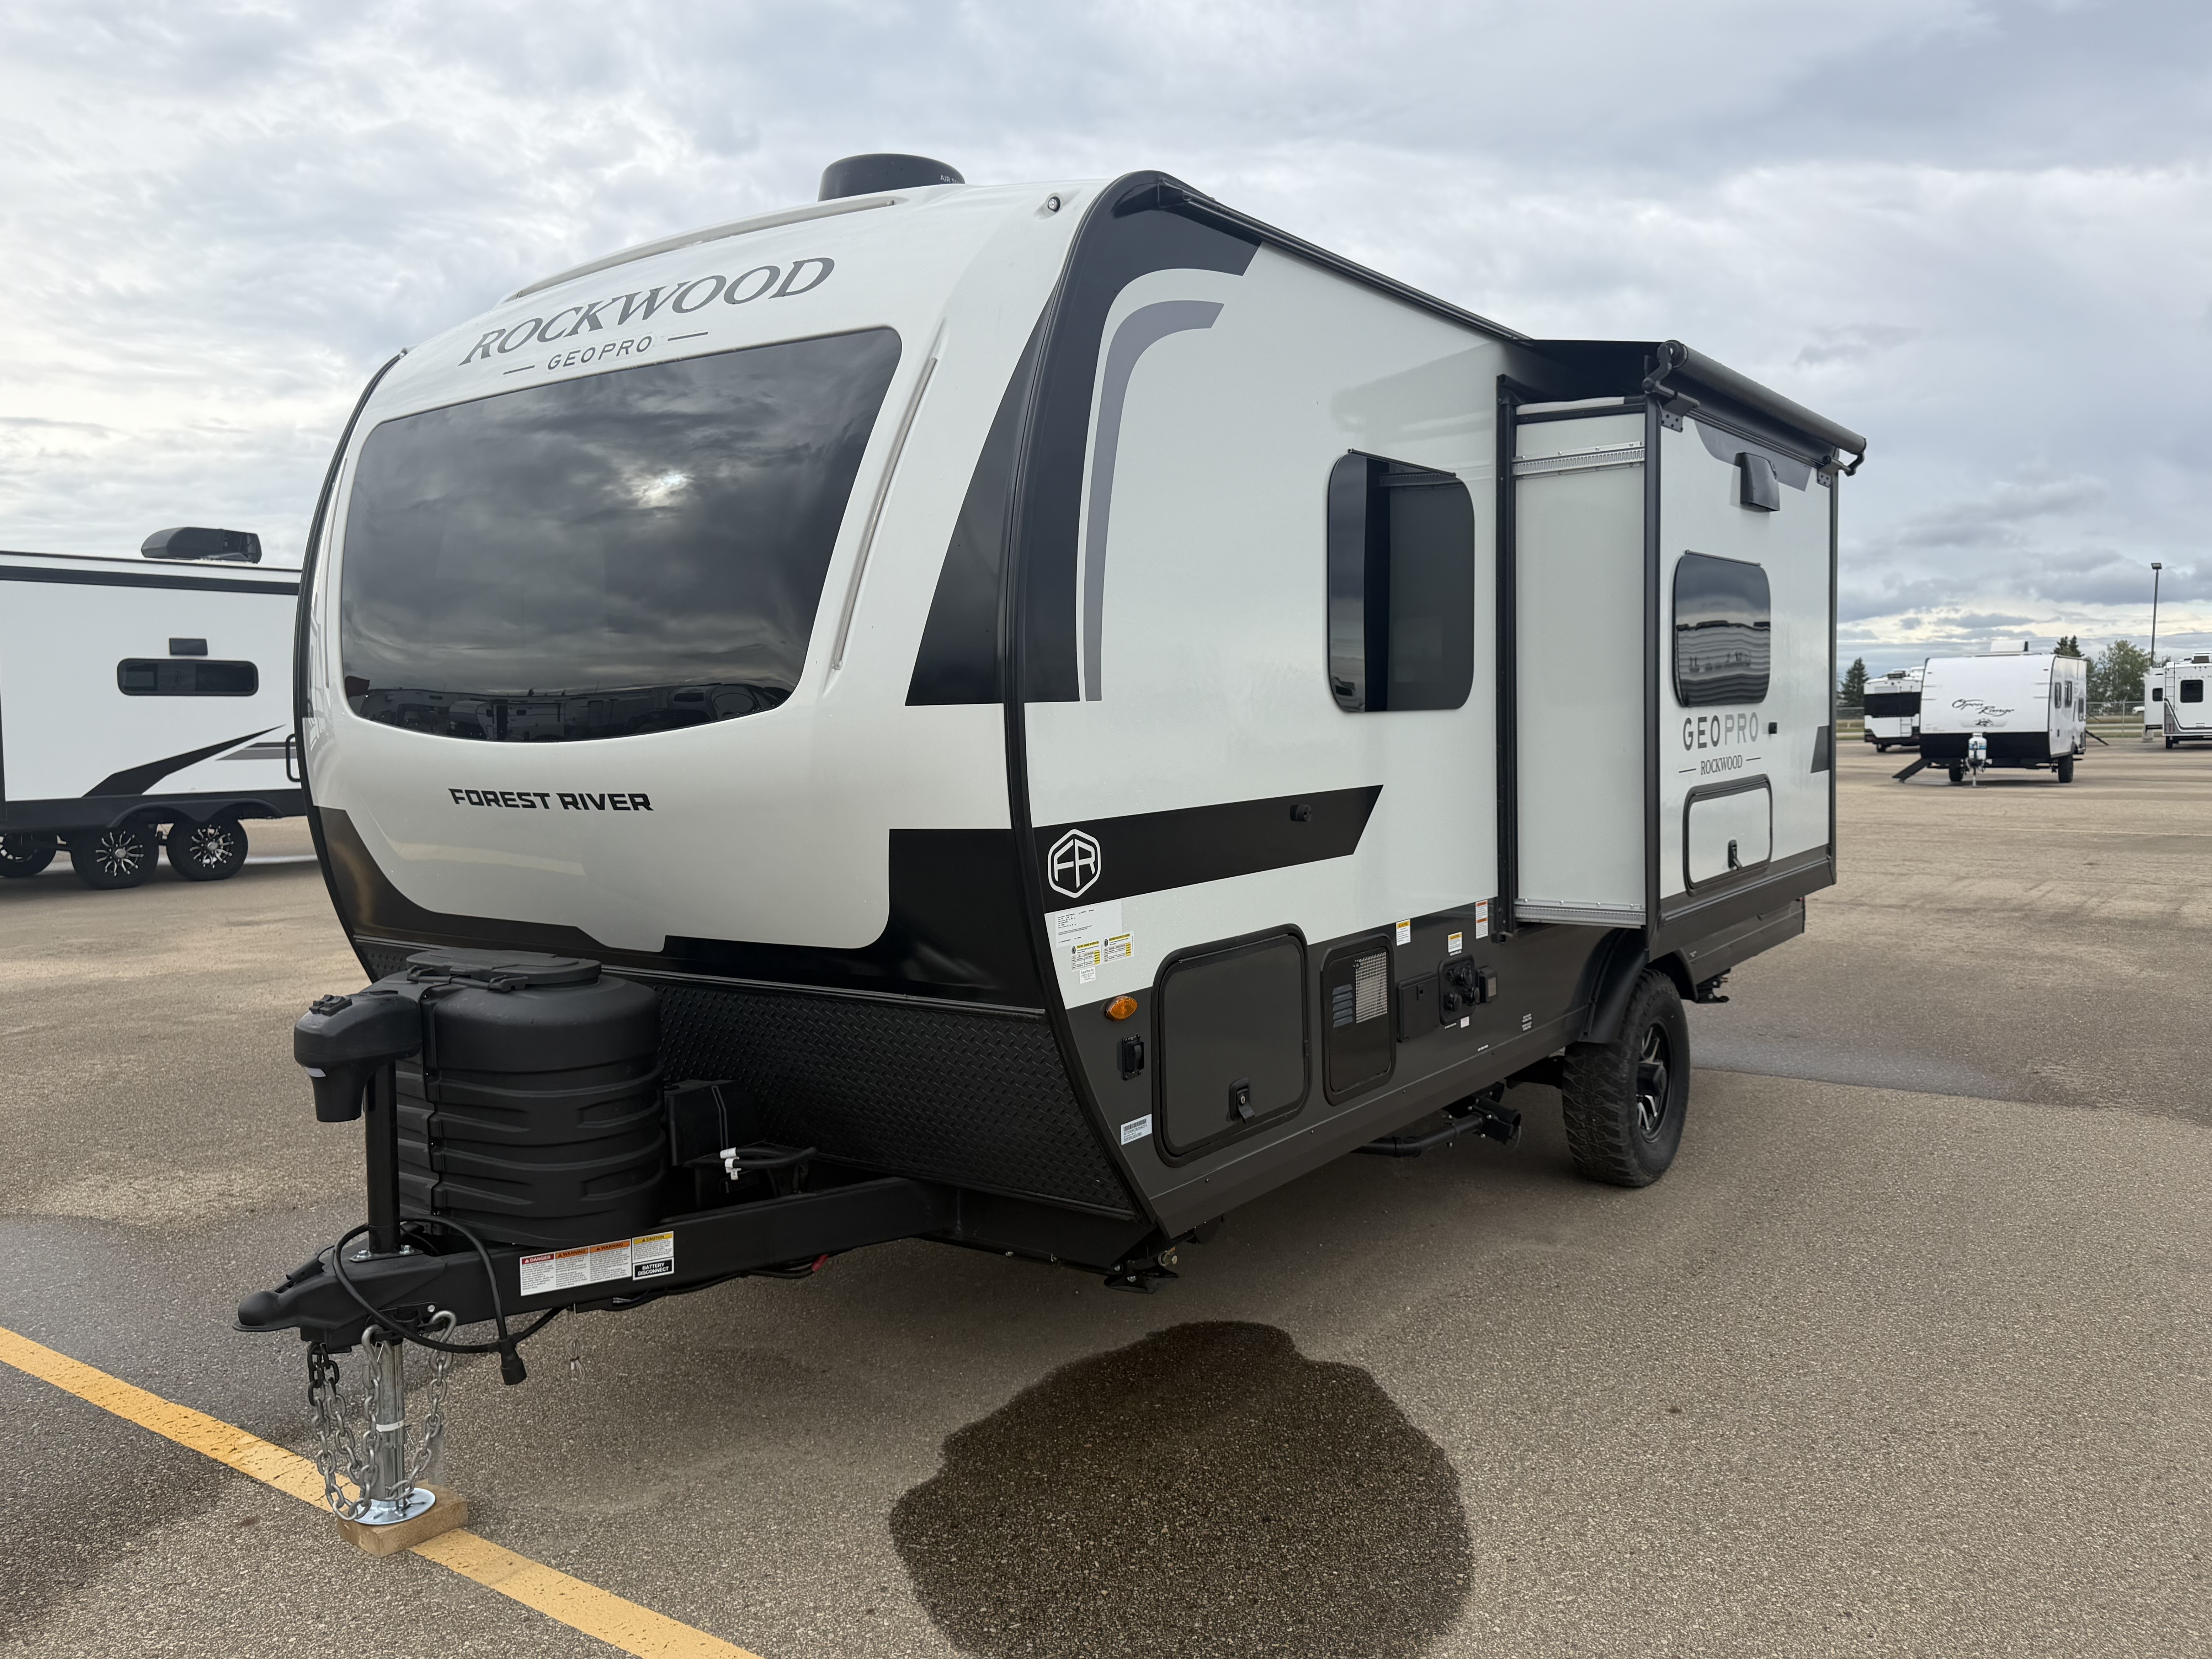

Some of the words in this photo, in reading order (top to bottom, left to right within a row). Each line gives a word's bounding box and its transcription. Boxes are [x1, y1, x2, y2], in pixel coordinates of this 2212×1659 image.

[940, 174, 950, 183] AIR
[458, 257, 835, 366] ROCKWOOD
[547, 335, 653, 371] GEOPRO
[1952, 699, 1984, 711] Open
[1975, 706, 2015, 717] Range
[1683, 711, 1759, 751] GEOPRO
[1700, 754, 1743, 775] ROCKWOOD
[448, 788, 550, 809] FOREST
[555, 792, 654, 811] RIVER
[638, 1266, 669, 1276] DISCONNECT
[642, 1262, 665, 1270] BATTERY
